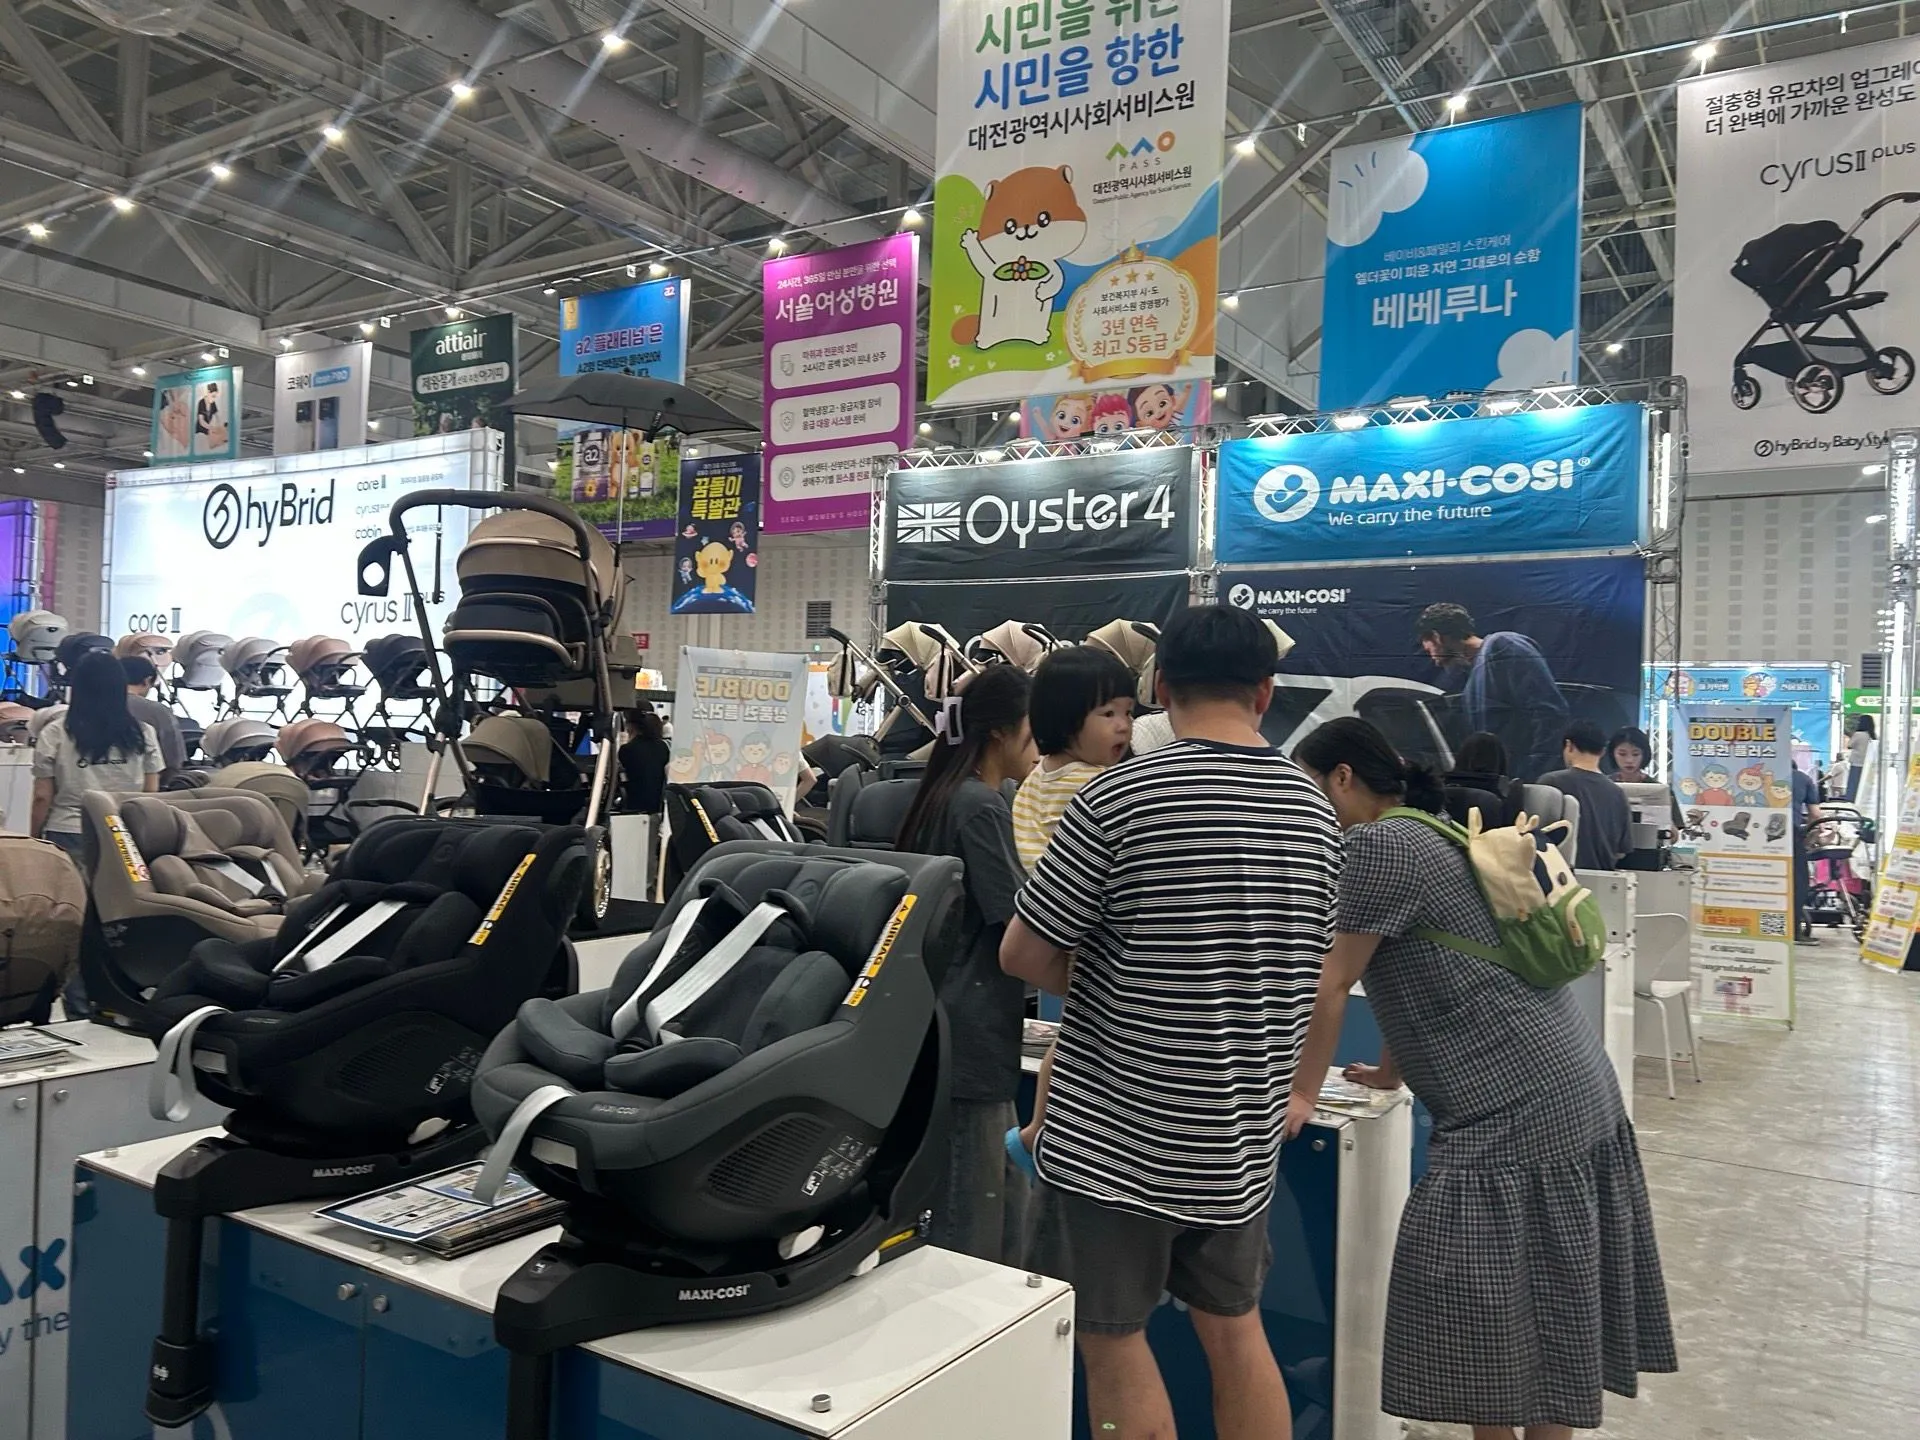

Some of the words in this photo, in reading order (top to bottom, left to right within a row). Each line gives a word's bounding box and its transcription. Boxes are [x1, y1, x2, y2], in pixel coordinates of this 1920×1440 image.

[975, 0, 1095, 54] 시민을
[974, 45, 1093, 110] 시민을
[1105, 22, 1184, 86] 향한
[1705, 88, 1762, 116] 절충형
[1767, 73, 1845, 104] 유모차의
[968, 79, 1196, 152] 대전광역시사회서비스원
[1705, 115, 1723, 136] 더
[1728, 106, 1785, 133] 완벽에
[1790, 96, 1851, 121] 가까운
[1855, 84, 1917, 111] 완성도
[1119, 157, 1162, 172] PASS
[1093, 165, 1192, 194] 대전광역시사회서비스원
[1405, 262, 1429, 279] 피운
[1431, 260, 1458, 276] 자연
[1459, 252, 1511, 272] 그대로의
[1513, 248, 1541, 265] 순함
[775, 278, 898, 323] 서울여성병원
[1092, 302, 1137, 316] 사회서비스원
[1372, 279, 1518, 329] 베베루나
[1101, 317, 1125, 336] 3년
[1130, 313, 1159, 333] 연속
[435, 328, 488, 355] attiair
[1092, 339, 1122, 357] 최고
[1125, 332, 1169, 354] S등급
[1776, 437, 1818, 456] hyBrid
[357, 480, 379, 491] core
[692, 475, 743, 499] 꿈돌이
[246, 478, 335, 547] hyBrid
[691, 497, 742, 520] 특별관
[966, 488, 1138, 549] Oyster
[1143, 484, 1176, 529] 4
[1329, 511, 1354, 527] We
[1357, 511, 1399, 527] carry
[1404, 507, 1434, 522] the
[1437, 503, 1492, 521] future
[129, 614, 168, 634] core
[340, 600, 398, 634] cyrus
[1257, 607, 1268, 615] We
[1268, 608, 1284, 616] carry
[1285, 606, 1296, 614] the
[1297, 606, 1318, 614] future
[1688, 724, 1776, 742] DOUBLE
[1688, 744, 1731, 757] 상품권
[1734, 744, 1776, 758] 플러스
[21, 1312, 70, 1341] the
